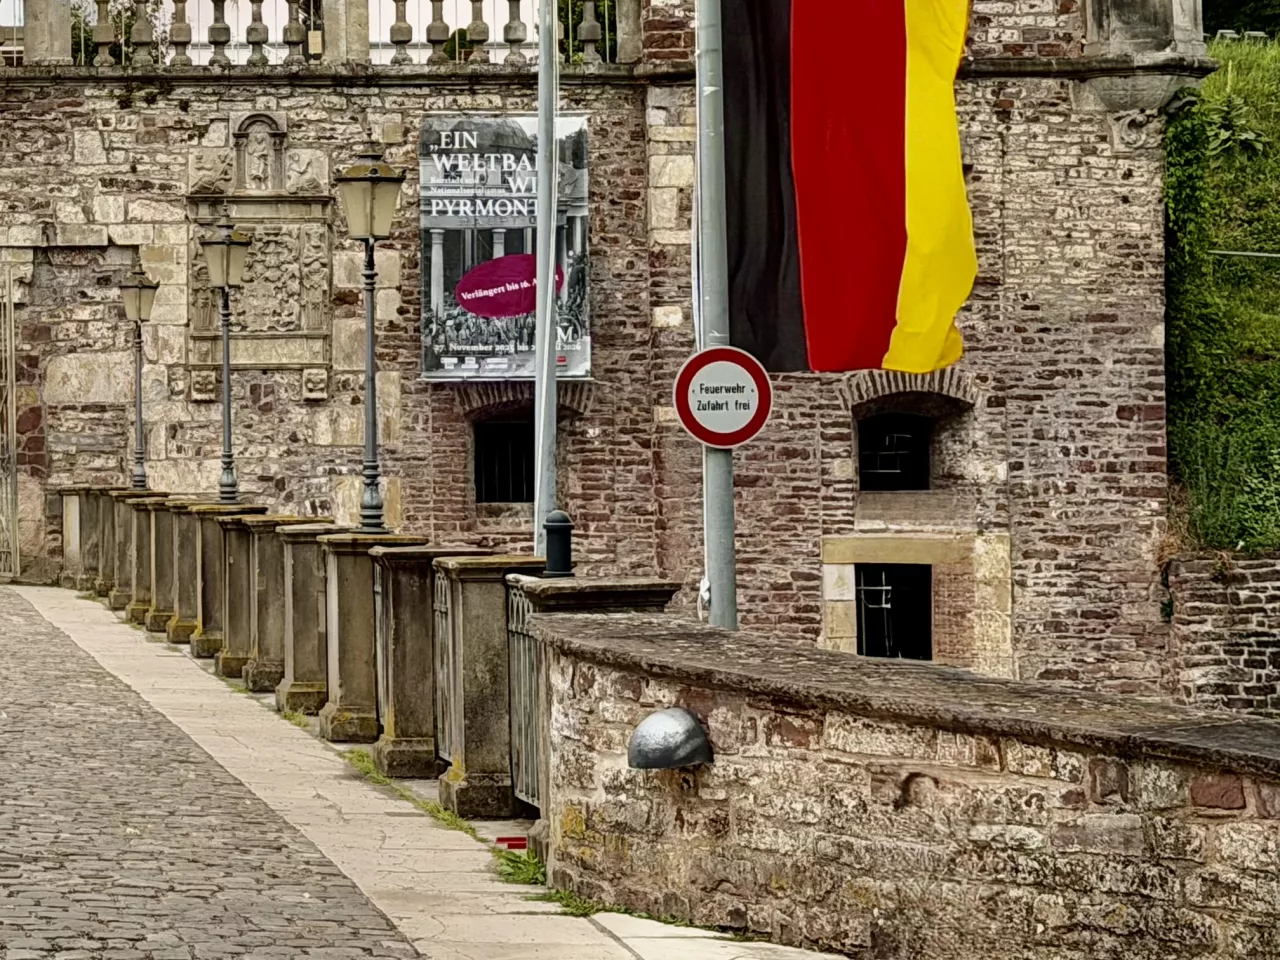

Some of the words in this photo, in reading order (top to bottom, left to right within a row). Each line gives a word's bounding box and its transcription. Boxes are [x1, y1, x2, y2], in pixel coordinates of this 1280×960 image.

[461, 285, 505, 300] Verlängert
[505, 281, 519, 292] bis
[449, 342, 493, 351] November
[517, 342, 529, 351] bis
[699, 383, 746, 394] Feuerwehr
[696, 400, 729, 411] Zufahrt
[735, 400, 751, 411] frei
